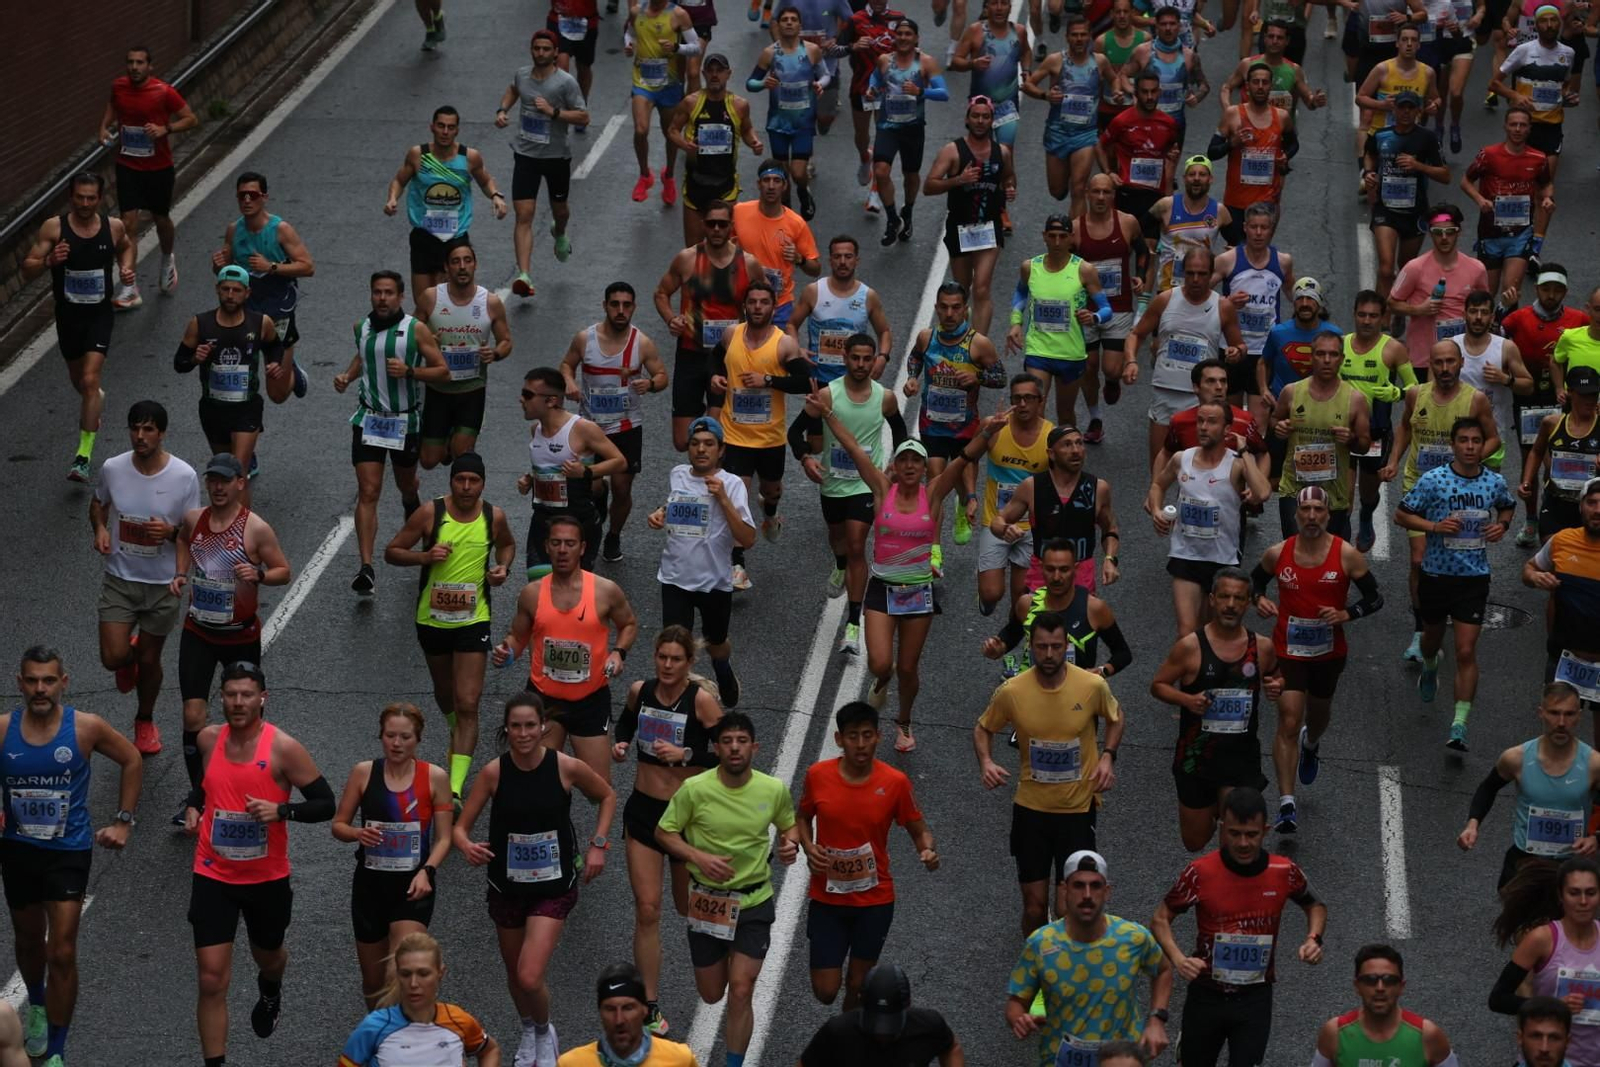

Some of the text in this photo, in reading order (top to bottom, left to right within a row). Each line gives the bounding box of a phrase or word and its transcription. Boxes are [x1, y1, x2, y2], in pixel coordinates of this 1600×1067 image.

[370, 419, 396, 432] 2441
[1001, 455, 1039, 470] WEST 4
[1299, 453, 1327, 467] 5328
[671, 505, 699, 519] 3094
[1184, 506, 1209, 521] 3211
[436, 592, 467, 607] 5344
[549, 649, 580, 665] 8470
[1564, 660, 1594, 678] 3107
[1209, 699, 1242, 715] 3268
[1036, 751, 1070, 765] 2222
[6, 776, 72, 785] GARMIN
[20, 801, 56, 817] 1816
[220, 822, 255, 839] 3295
[1536, 818, 1571, 836] 1991
[514, 844, 548, 861] 3355
[831, 859, 864, 875] 4323
[694, 898, 727, 915] 4324
[1222, 946, 1258, 963] 2103
